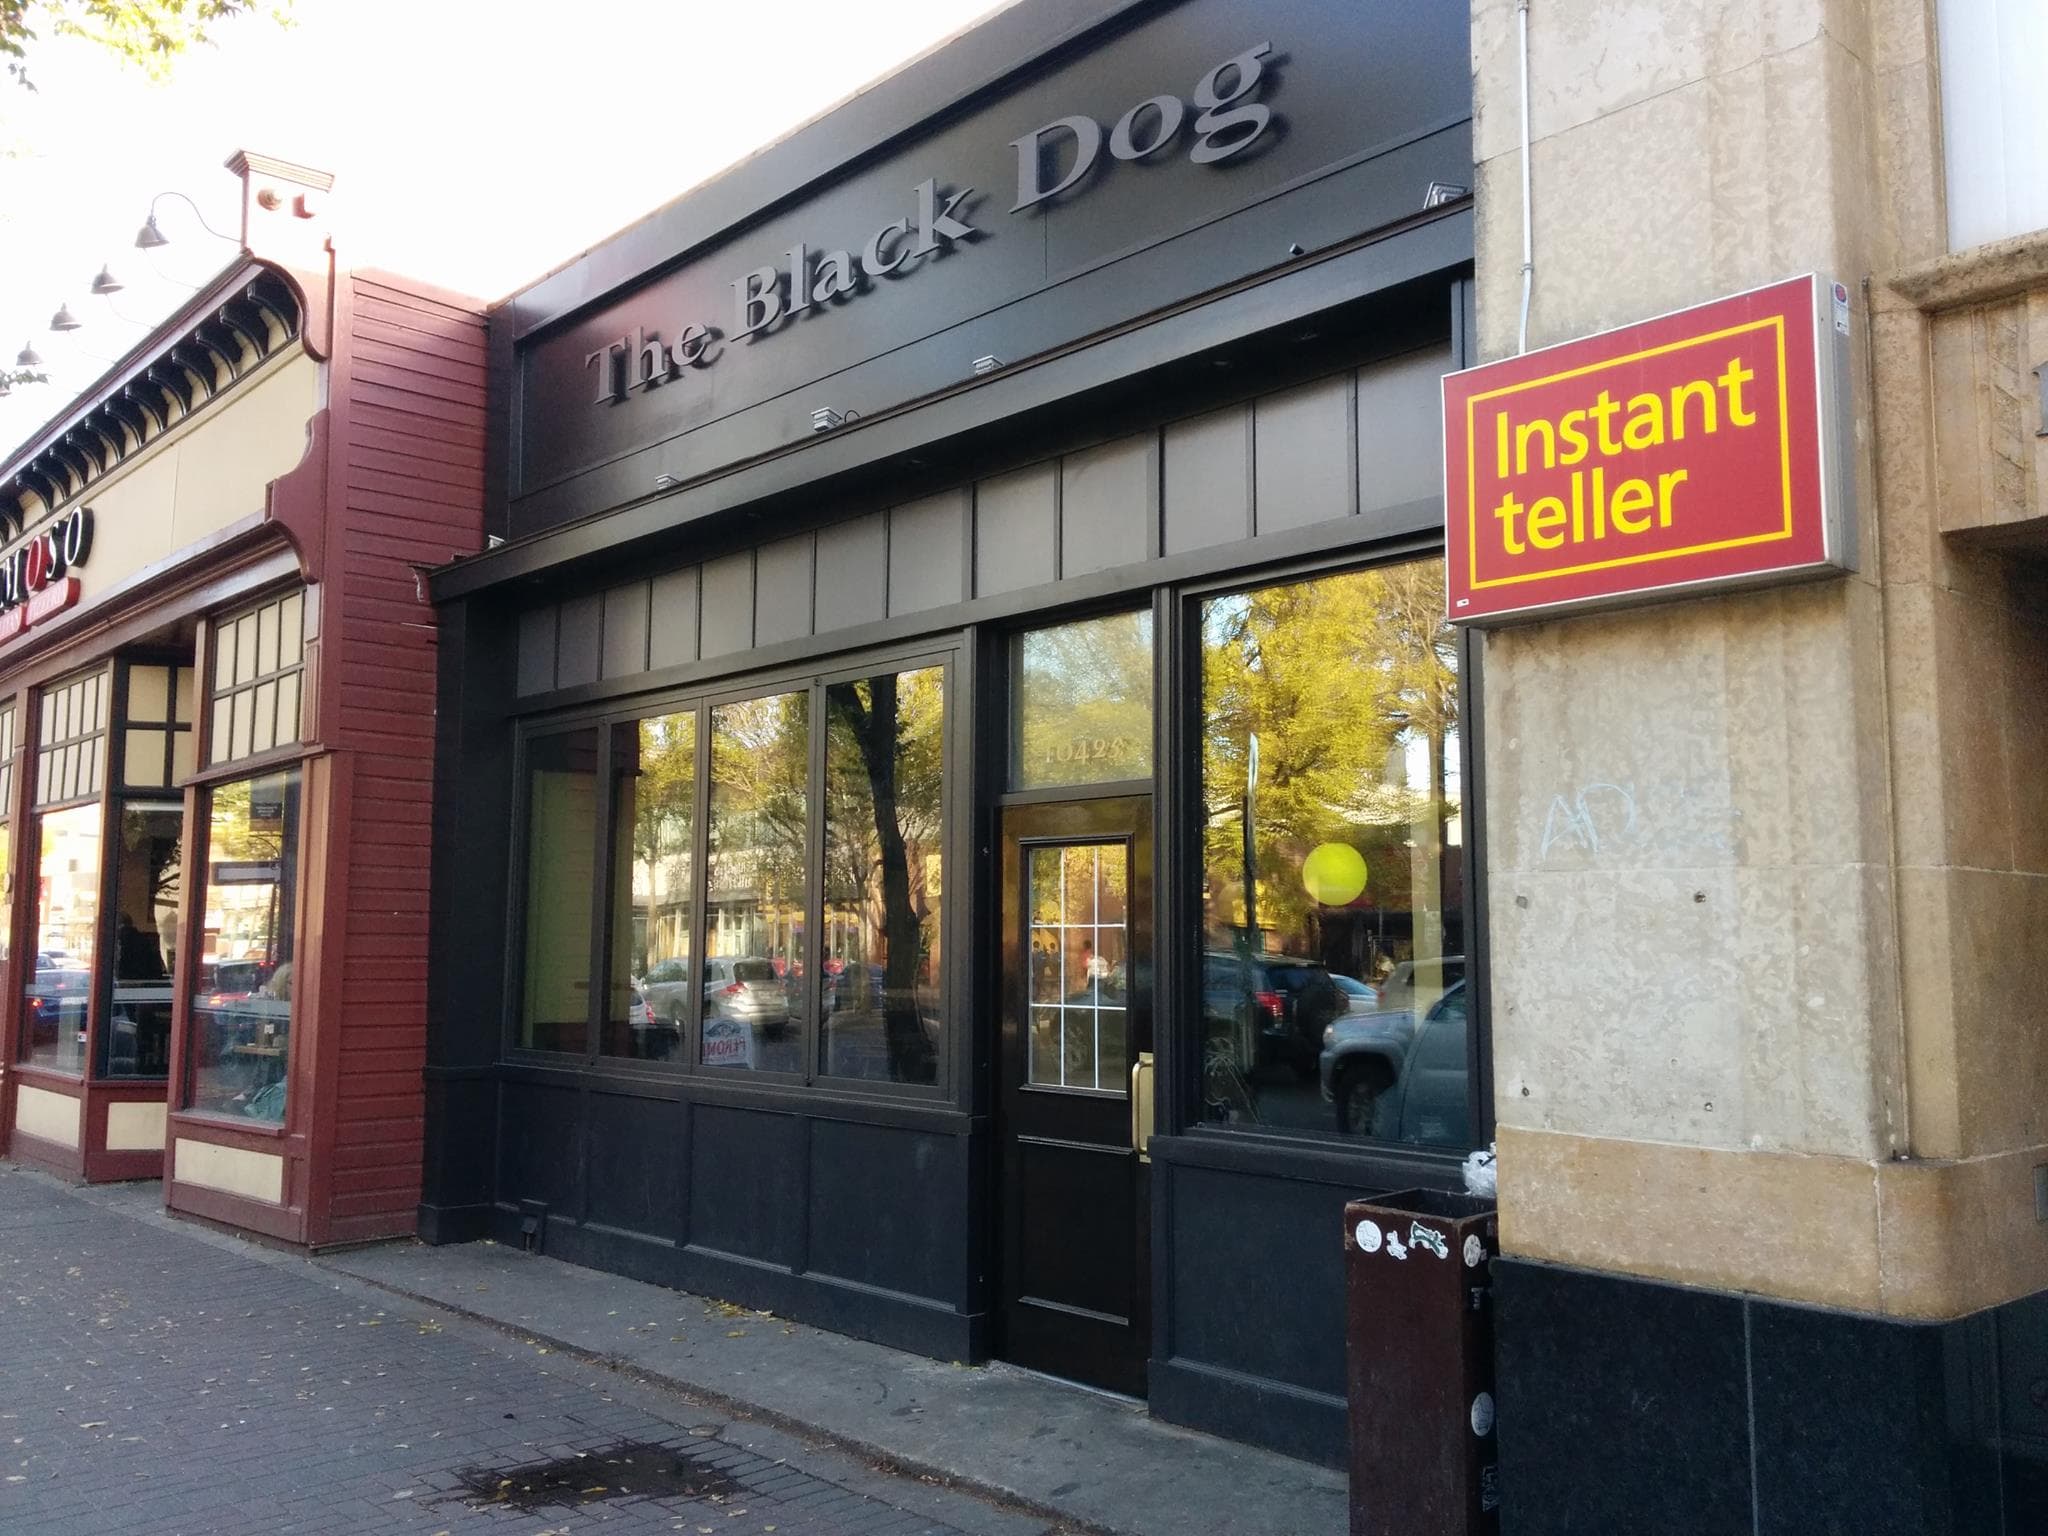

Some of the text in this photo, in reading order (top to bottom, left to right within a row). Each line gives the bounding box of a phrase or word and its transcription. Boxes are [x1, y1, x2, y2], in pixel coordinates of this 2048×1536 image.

[585, 40, 1272, 405] The Black Dog
[1496, 357, 1756, 479] Instant
[1494, 466, 1688, 556] teller
